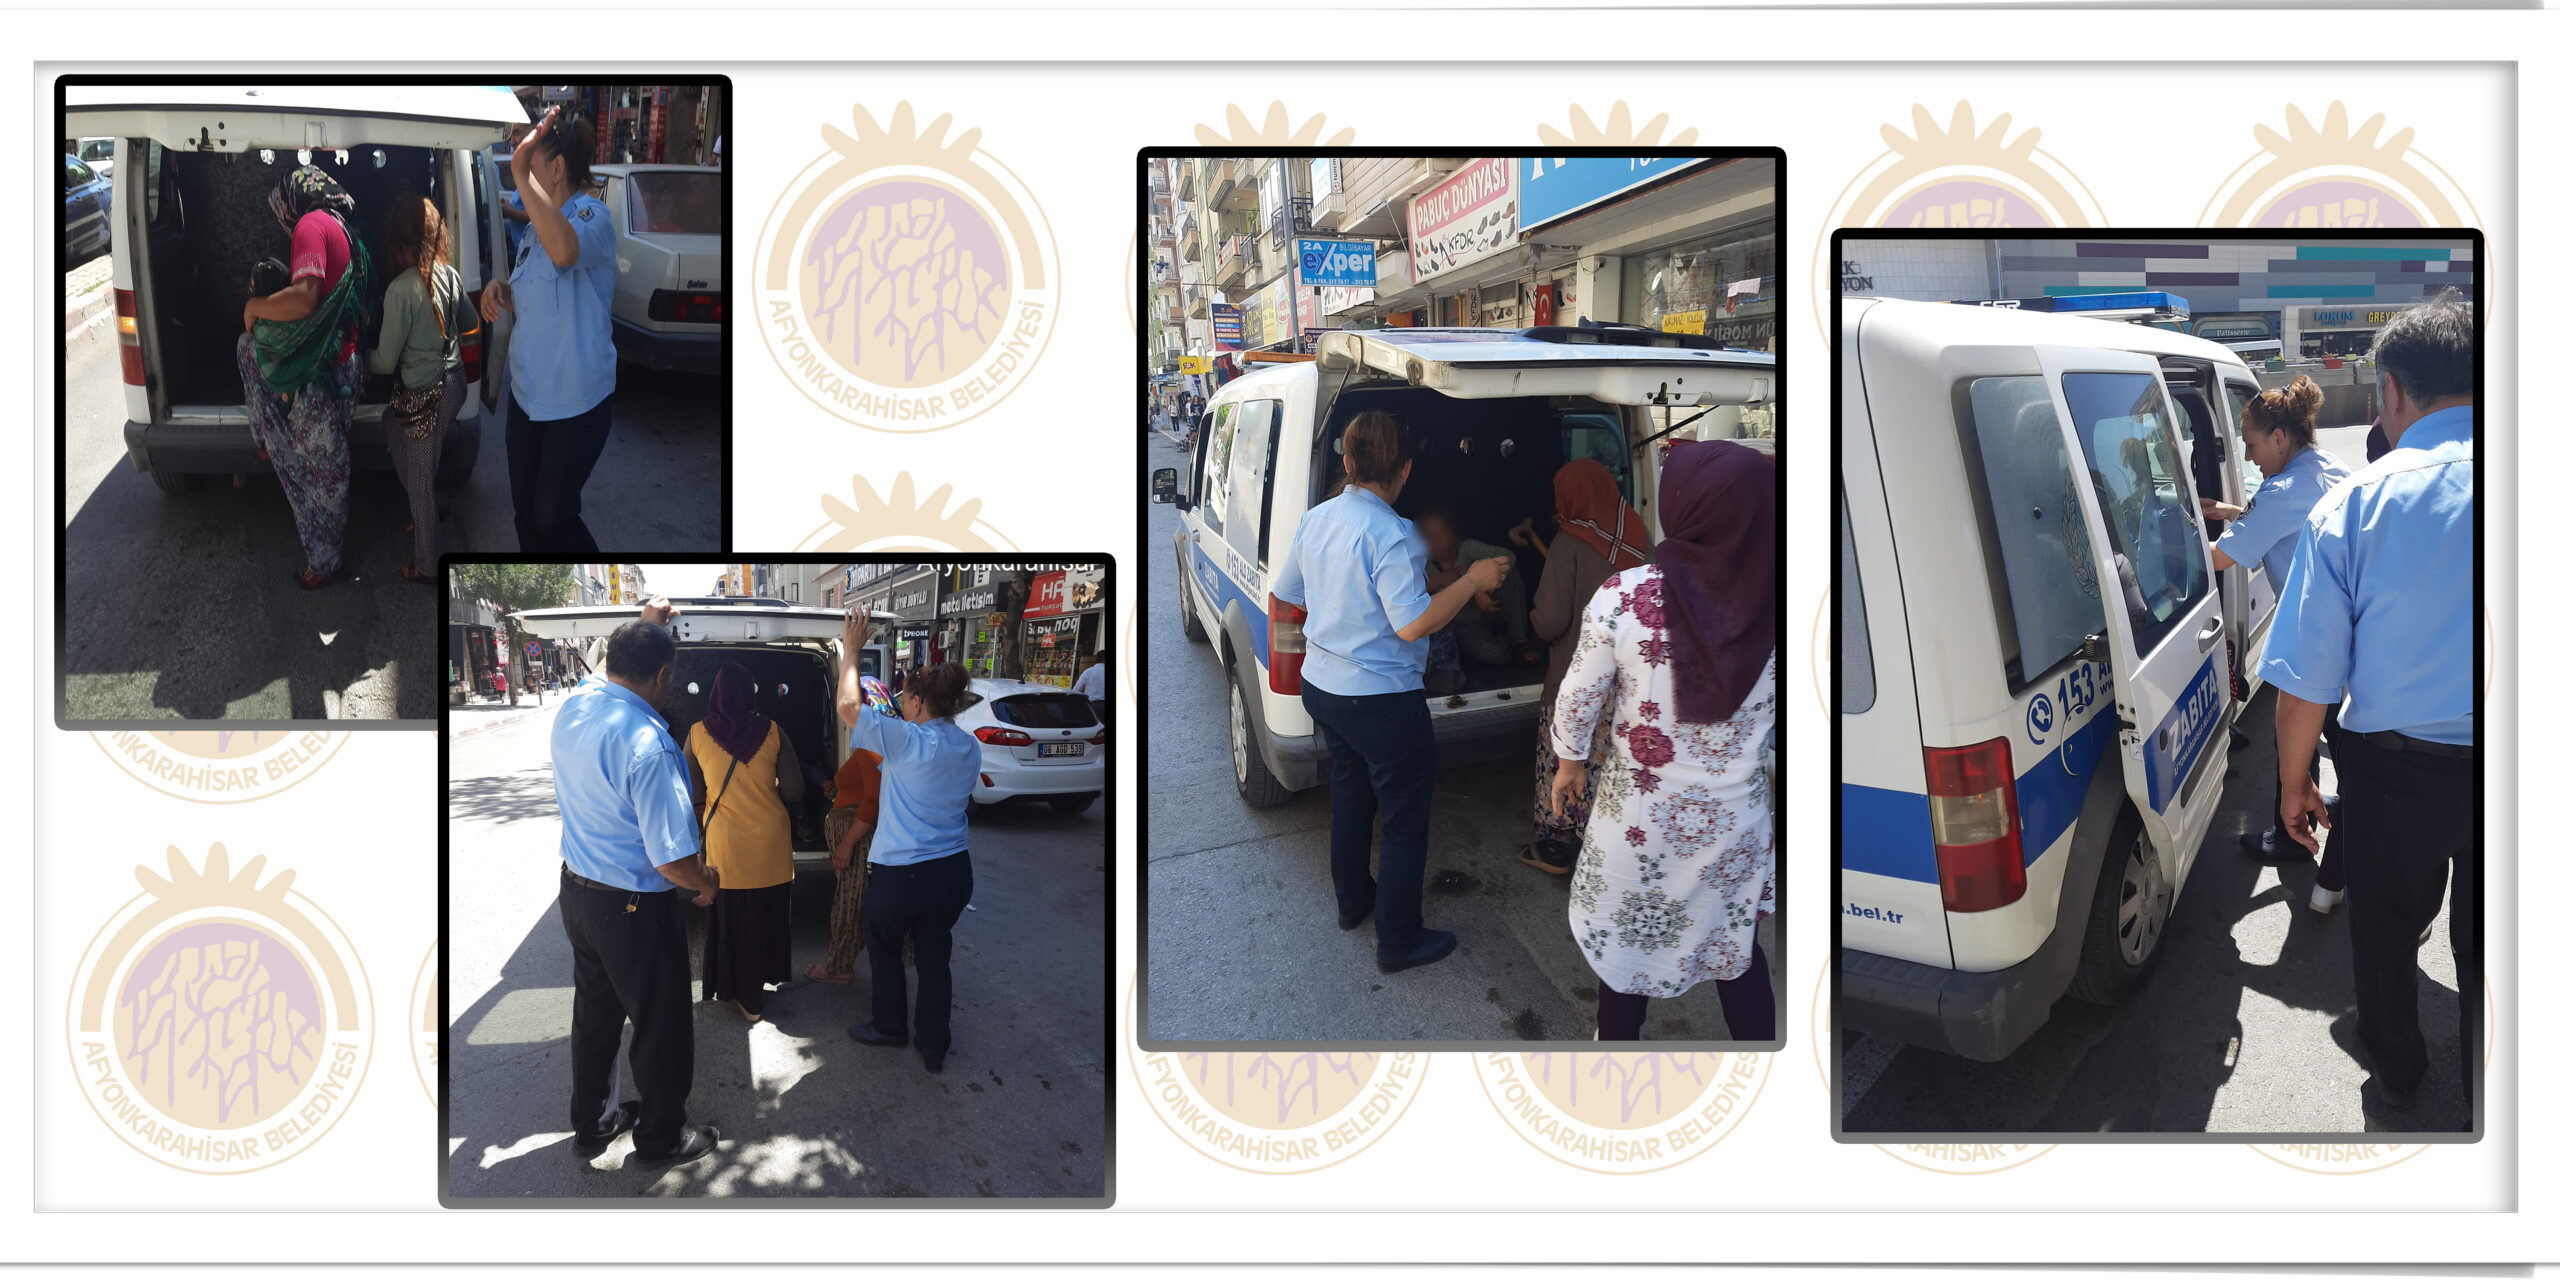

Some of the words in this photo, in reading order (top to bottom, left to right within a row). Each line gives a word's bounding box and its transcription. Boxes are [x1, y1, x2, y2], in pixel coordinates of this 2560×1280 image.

[1416, 190, 1451, 232] PABUÇ
[1451, 157, 1506, 215] DÜNYASI
[1302, 242, 1323, 251] 2A
[940, 597, 961, 615] meta
[2058, 662, 2095, 720] 153
[2168, 668, 2219, 763] ZABITA
[1043, 745, 1052, 754] 06
[1070, 744, 1083, 753] 539
